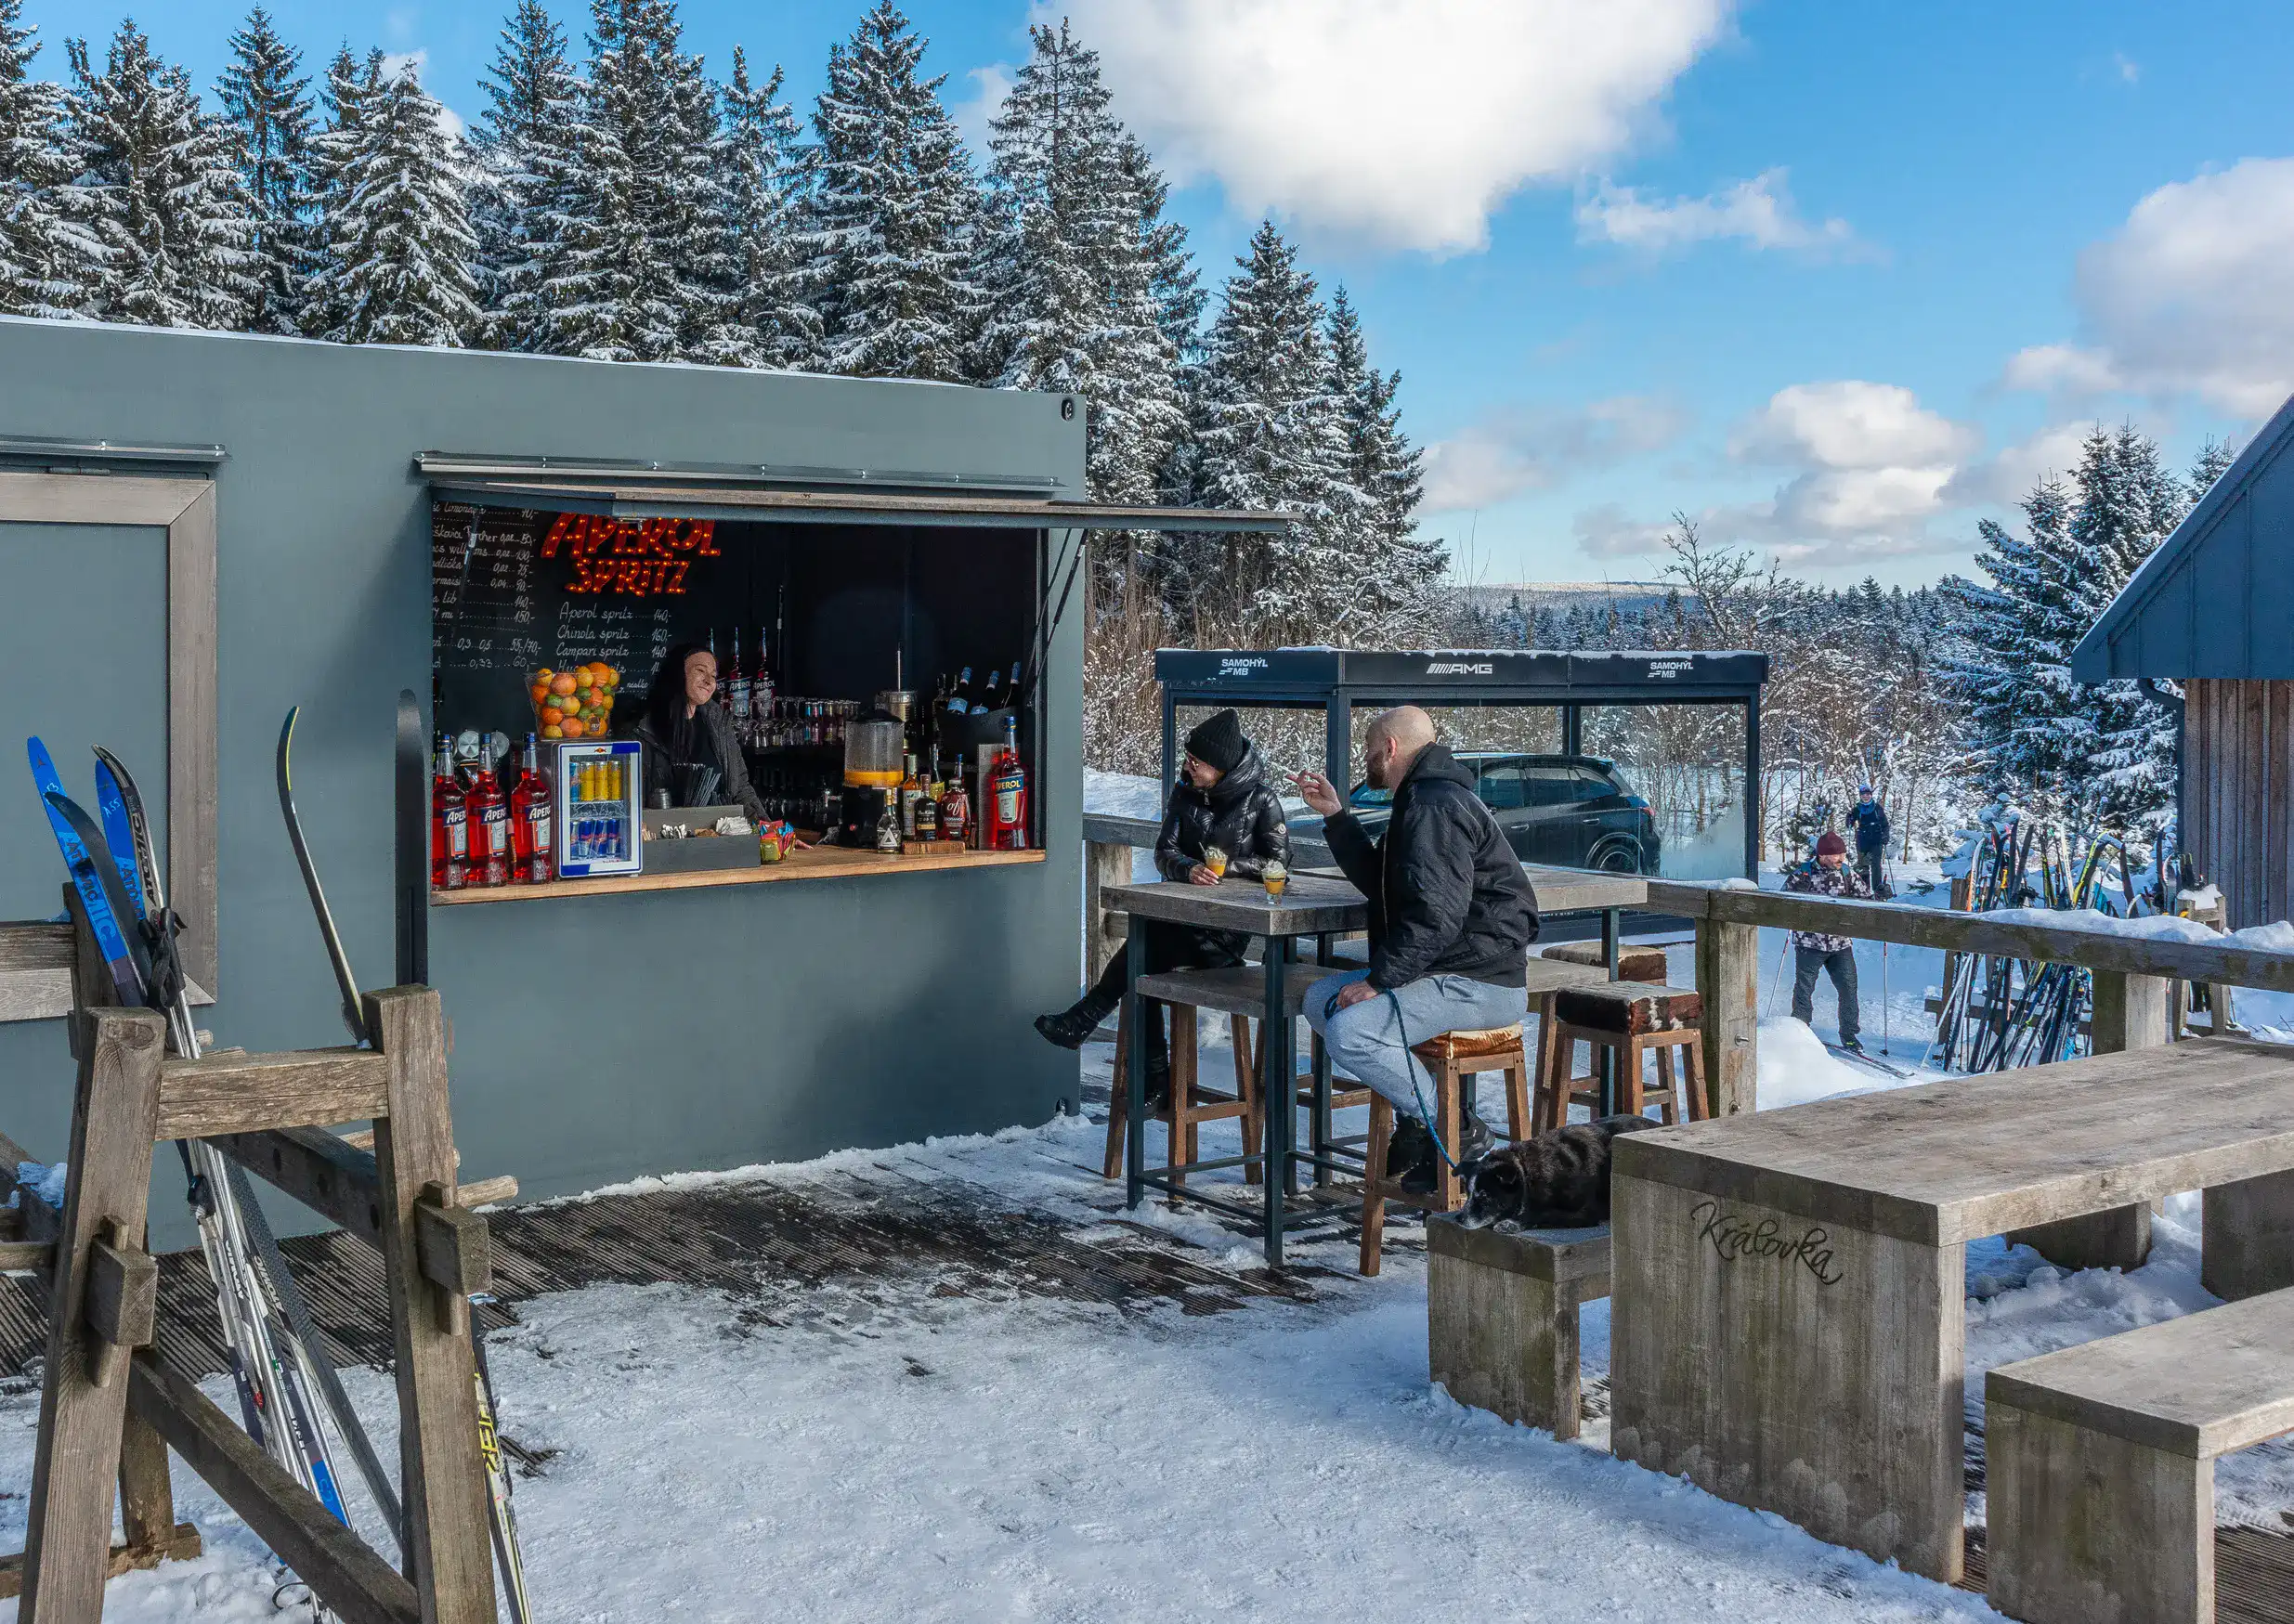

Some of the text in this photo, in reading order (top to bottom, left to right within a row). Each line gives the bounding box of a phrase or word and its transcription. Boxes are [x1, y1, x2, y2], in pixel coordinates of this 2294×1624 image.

[541, 513, 722, 559] APEROL
[565, 559, 691, 598] SPRITZ
[514, 594, 535, 610] 140,-
[514, 610, 536, 625] 150,-
[559, 601, 672, 624] Aperol spritz 140,-
[557, 624, 672, 644] Chinola spritz 160,-
[457, 637, 472, 651] 0,3
[478, 638, 493, 653] 0,5
[555, 642, 597, 661] Campari
[598, 643, 630, 661] spritz
[469, 658, 493, 670] 0,33
[513, 655, 539, 671] 60,-
[1221, 657, 1269, 668] SAMOHÝL
[1649, 660, 1694, 670] SAMOHÝL
[1232, 668, 1249, 676] MB
[1661, 669, 1676, 679] MB
[254, 1254, 285, 1313] ATOMIC
